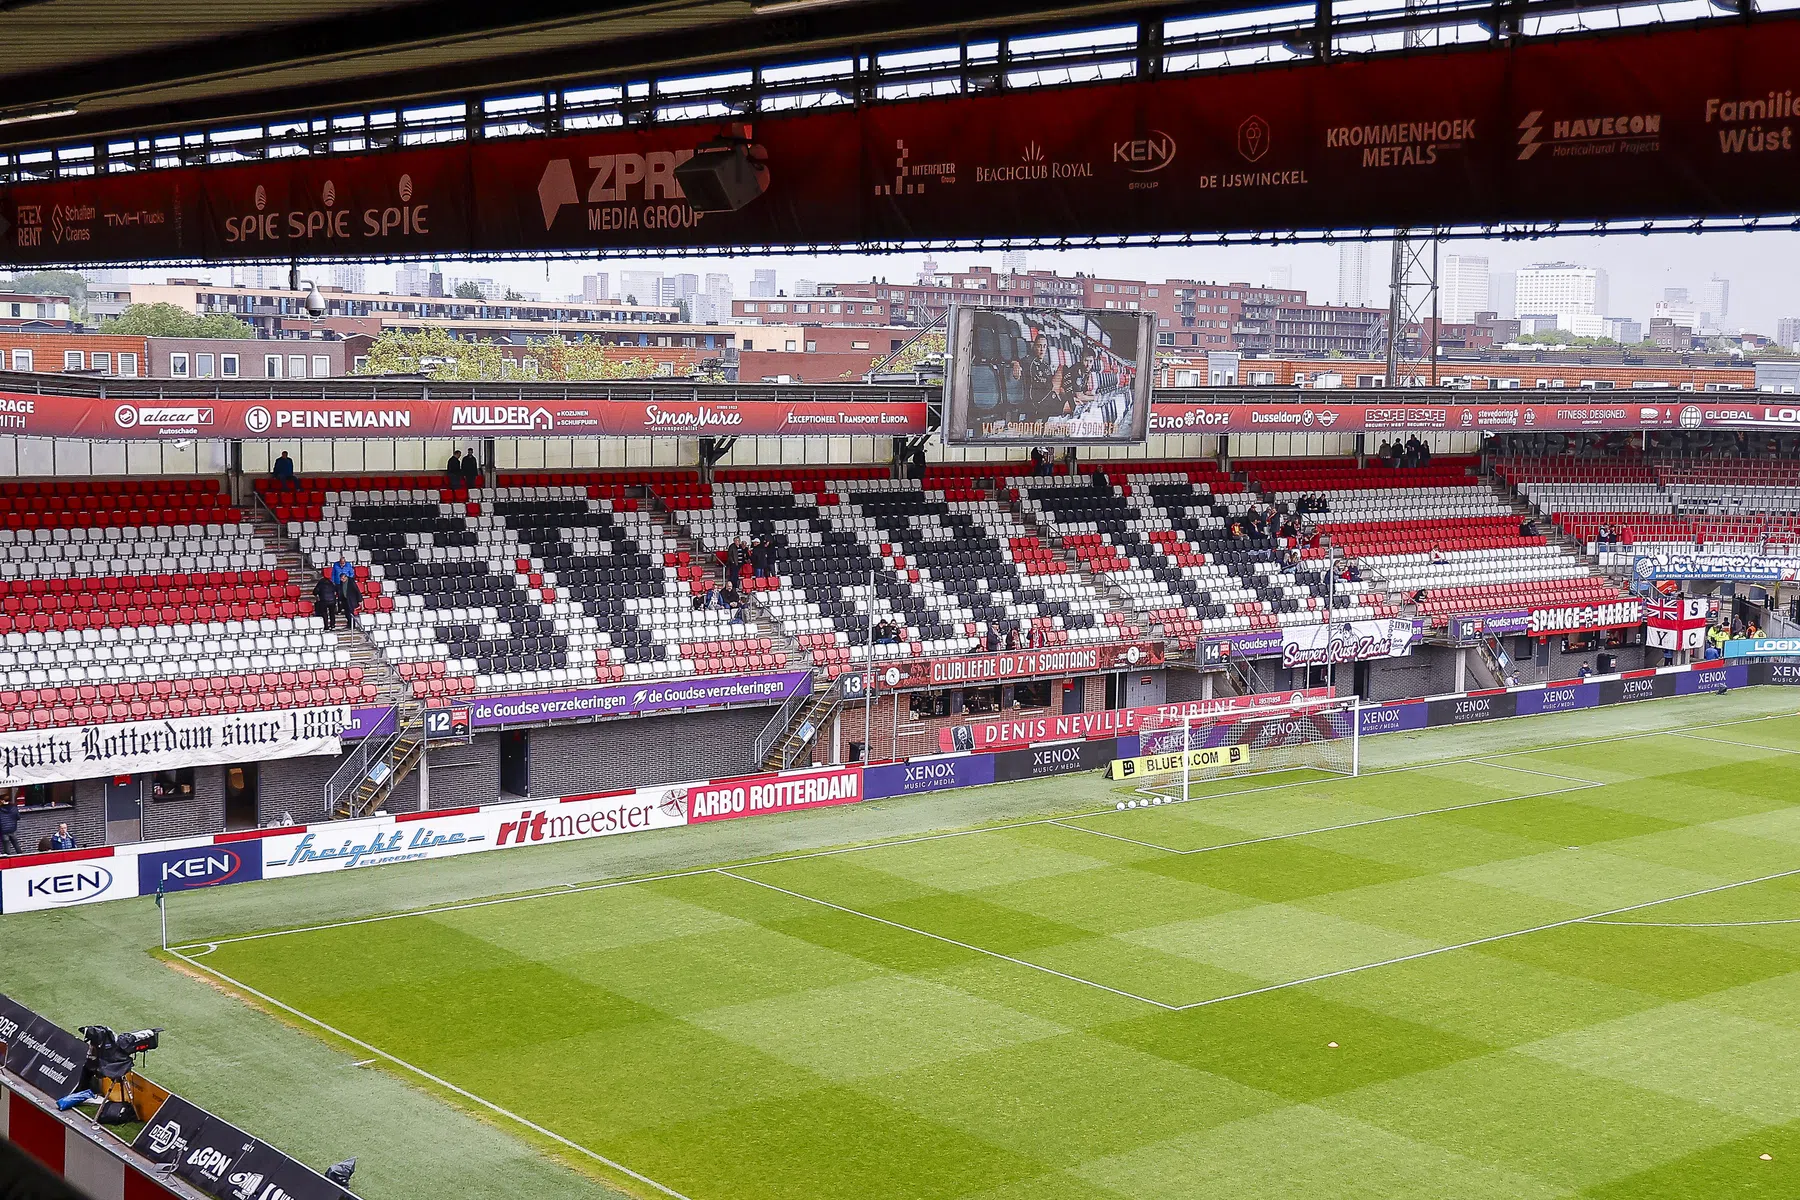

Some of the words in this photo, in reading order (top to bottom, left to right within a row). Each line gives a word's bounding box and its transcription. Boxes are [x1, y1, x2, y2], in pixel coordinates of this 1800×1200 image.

[1326, 118, 1476, 148] KROMMENHOEK
[1553, 115, 1661, 138] HAVECON
[1719, 125, 1792, 154] Wüst
[1113, 138, 1167, 163] KEN
[1362, 144, 1437, 168] METALS
[1552, 141, 1615, 157] Horticultural
[1620, 141, 1660, 156] Projects
[912, 163, 956, 176] INTERFILTER
[976, 165, 1048, 183] BEACHCLUB
[1052, 162, 1093, 179] ROYAL
[941, 175, 956, 184] Group
[1128, 181, 1159, 190] GROUP
[1199, 175, 1217, 188] DE
[1222, 170, 1308, 188] IJSWINCKEL
[17, 204, 42, 225] FLEX
[104, 212, 139, 227] TMH
[142, 210, 165, 225] Trucks
[363, 204, 429, 237] SPIE
[588, 206, 640, 231] MEDIA
[643, 204, 705, 229] GROUP
[65, 226, 91, 241] Cranes
[225, 212, 280, 242] SPIE
[288, 210, 350, 239] SPIE
[17, 226, 43, 246] RENT
[144, 410, 194, 422] alacar
[276, 410, 411, 428] PEINEMANN
[452, 406, 530, 425] MULDER
[644, 404, 697, 426] Simon
[693, 406, 743, 427] Maree
[1252, 411, 1301, 425] Dusseldorp
[1478, 417, 1516, 426] warehousing
[1557, 409, 1589, 420] FITNESS.
[1590, 409, 1627, 420] DESIGNED.
[1705, 410, 1754, 420] GLOBAL
[1764, 408, 1800, 421] LO
[159, 427, 198, 435] Autoschade
[1532, 606, 1580, 632] SPANGE
[1597, 601, 1640, 626] NAREN
[1689, 601, 1699, 616] S
[1462, 622, 1474, 636] 15
[1486, 617, 1510, 628] Goudse
[1240, 638, 1267, 650] Goudse
[1656, 630, 1668, 646] Y
[1688, 632, 1697, 647] C
[1205, 645, 1219, 660] 14
[1284, 641, 1327, 665] Semper,
[1329, 640, 1358, 662] Rust
[1358, 636, 1392, 659] Zacht
[934, 661, 996, 682] CLUBLIEFDE
[1000, 660, 1014, 676] OP
[1016, 654, 1036, 674] Z'N
[1038, 650, 1097, 672] SPARTAANS
[844, 676, 861, 693] 13
[1623, 679, 1653, 693] XENOX
[1698, 671, 1727, 684] XENOX
[648, 690, 662, 703] de
[664, 687, 706, 702] Goudse
[707, 680, 784, 698] verzekeringen
[1543, 689, 1575, 703] XENOX
[473, 705, 488, 717] de
[490, 701, 534, 715] Goudse
[535, 694, 617, 712] verzekeringen
[1455, 699, 1490, 713] XENOX
[426, 711, 448, 729] 12
[1363, 709, 1400, 724] XENOX
[985, 719, 1046, 743] DENIS
[1056, 711, 1135, 735] NEVILLE
[1262, 721, 1302, 736] XENOX
[0, 735, 72, 778] parta
[81, 721, 213, 762] Rotterdam
[221, 717, 281, 747] since
[1033, 747, 1080, 765] XENOX
[1033, 765, 1054, 773] MUSIC
[1060, 762, 1081, 770] MEDIA
[1147, 751, 1219, 772] BLUE1.COM
[905, 762, 955, 782] XENOX
[904, 782, 926, 790] MUSIC
[934, 778, 955, 786] MEDIA
[692, 787, 746, 818] ARBO
[750, 773, 858, 810] ROTTERDAM
[496, 804, 653, 846] ritmeester
[287, 830, 404, 868] freight
[407, 827, 466, 850] line
[162, 854, 229, 881] KEN
[360, 852, 429, 866] EUROPE
[28, 871, 99, 897] KEN
[150, 1124, 172, 1145] DELTA
